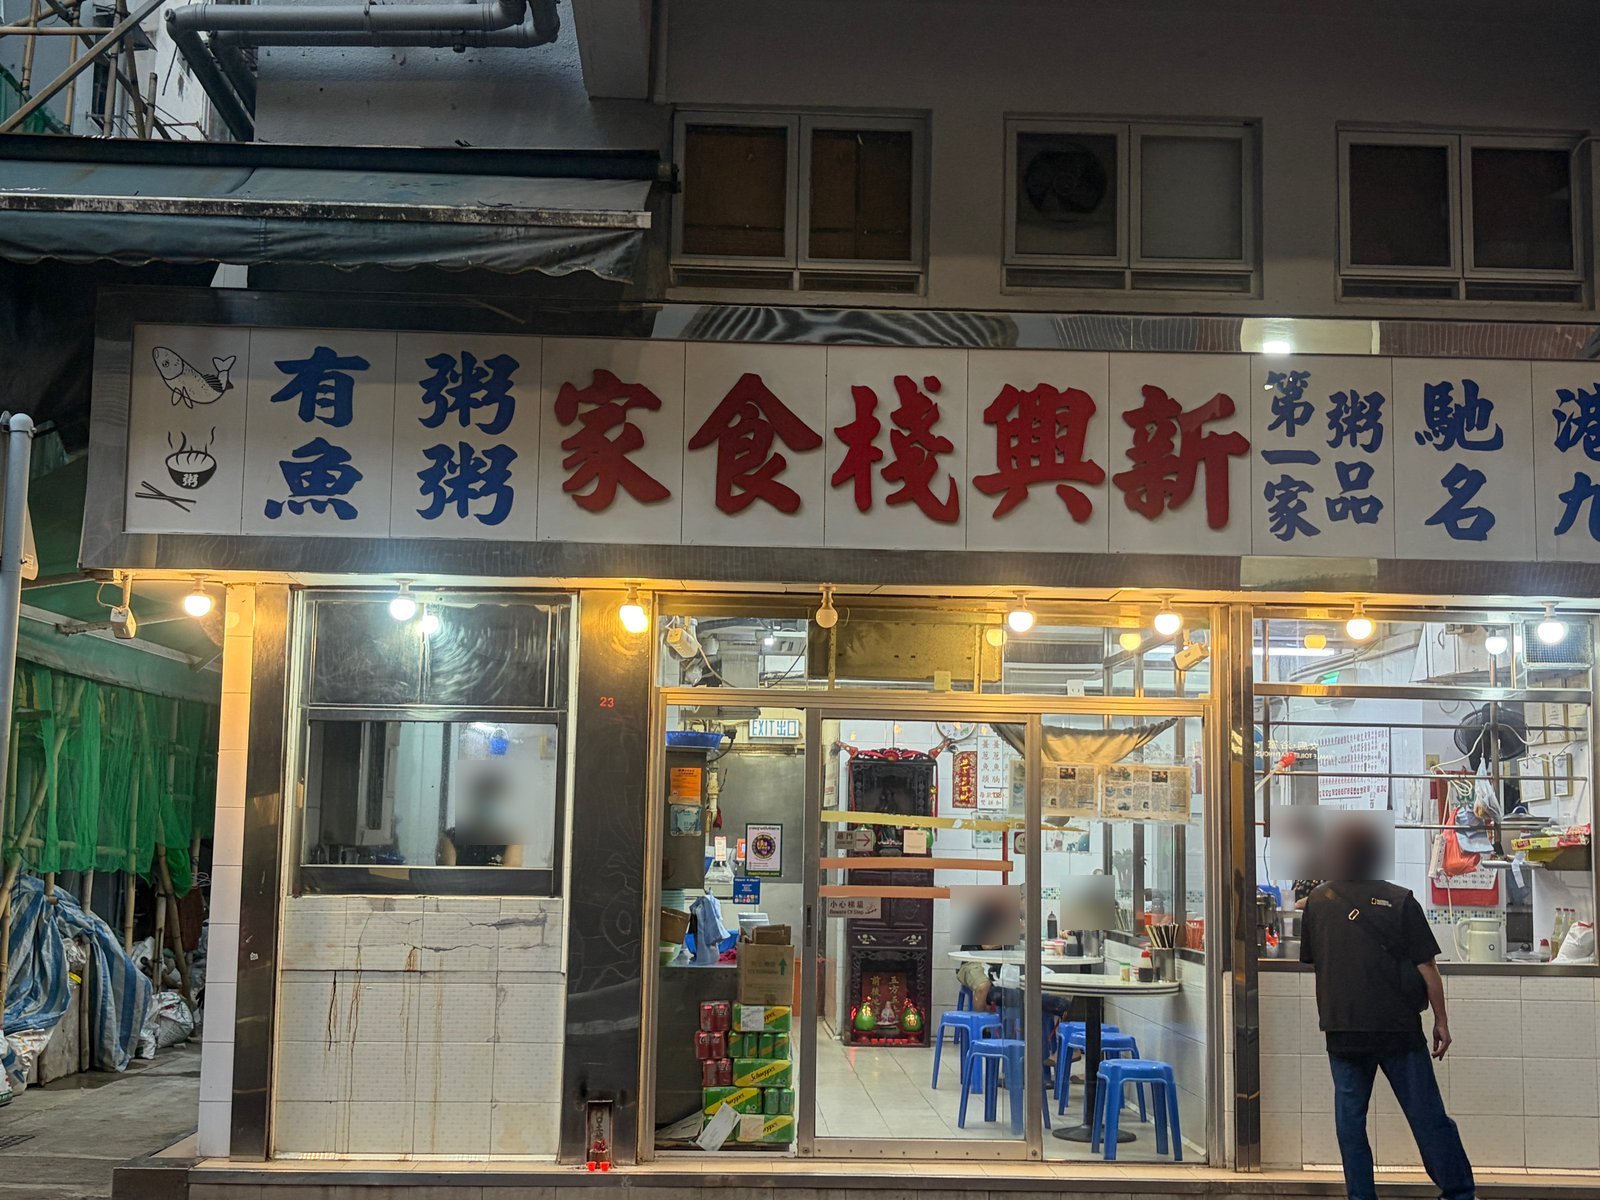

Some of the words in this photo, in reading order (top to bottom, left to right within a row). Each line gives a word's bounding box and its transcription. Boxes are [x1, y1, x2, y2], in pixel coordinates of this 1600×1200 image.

[182, 473, 198, 487] 粥
[264, 346, 370, 520] 有魚
[416, 351, 520, 525] 粥粥
[1260, 371, 1321, 541] 第一家
[1325, 389, 1386, 524] 粥品
[1415, 379, 1504, 541] 馳名
[600, 696, 615, 708] 23
[752, 720, 776, 736] EXIT
[776, 720, 798, 736] 出口
